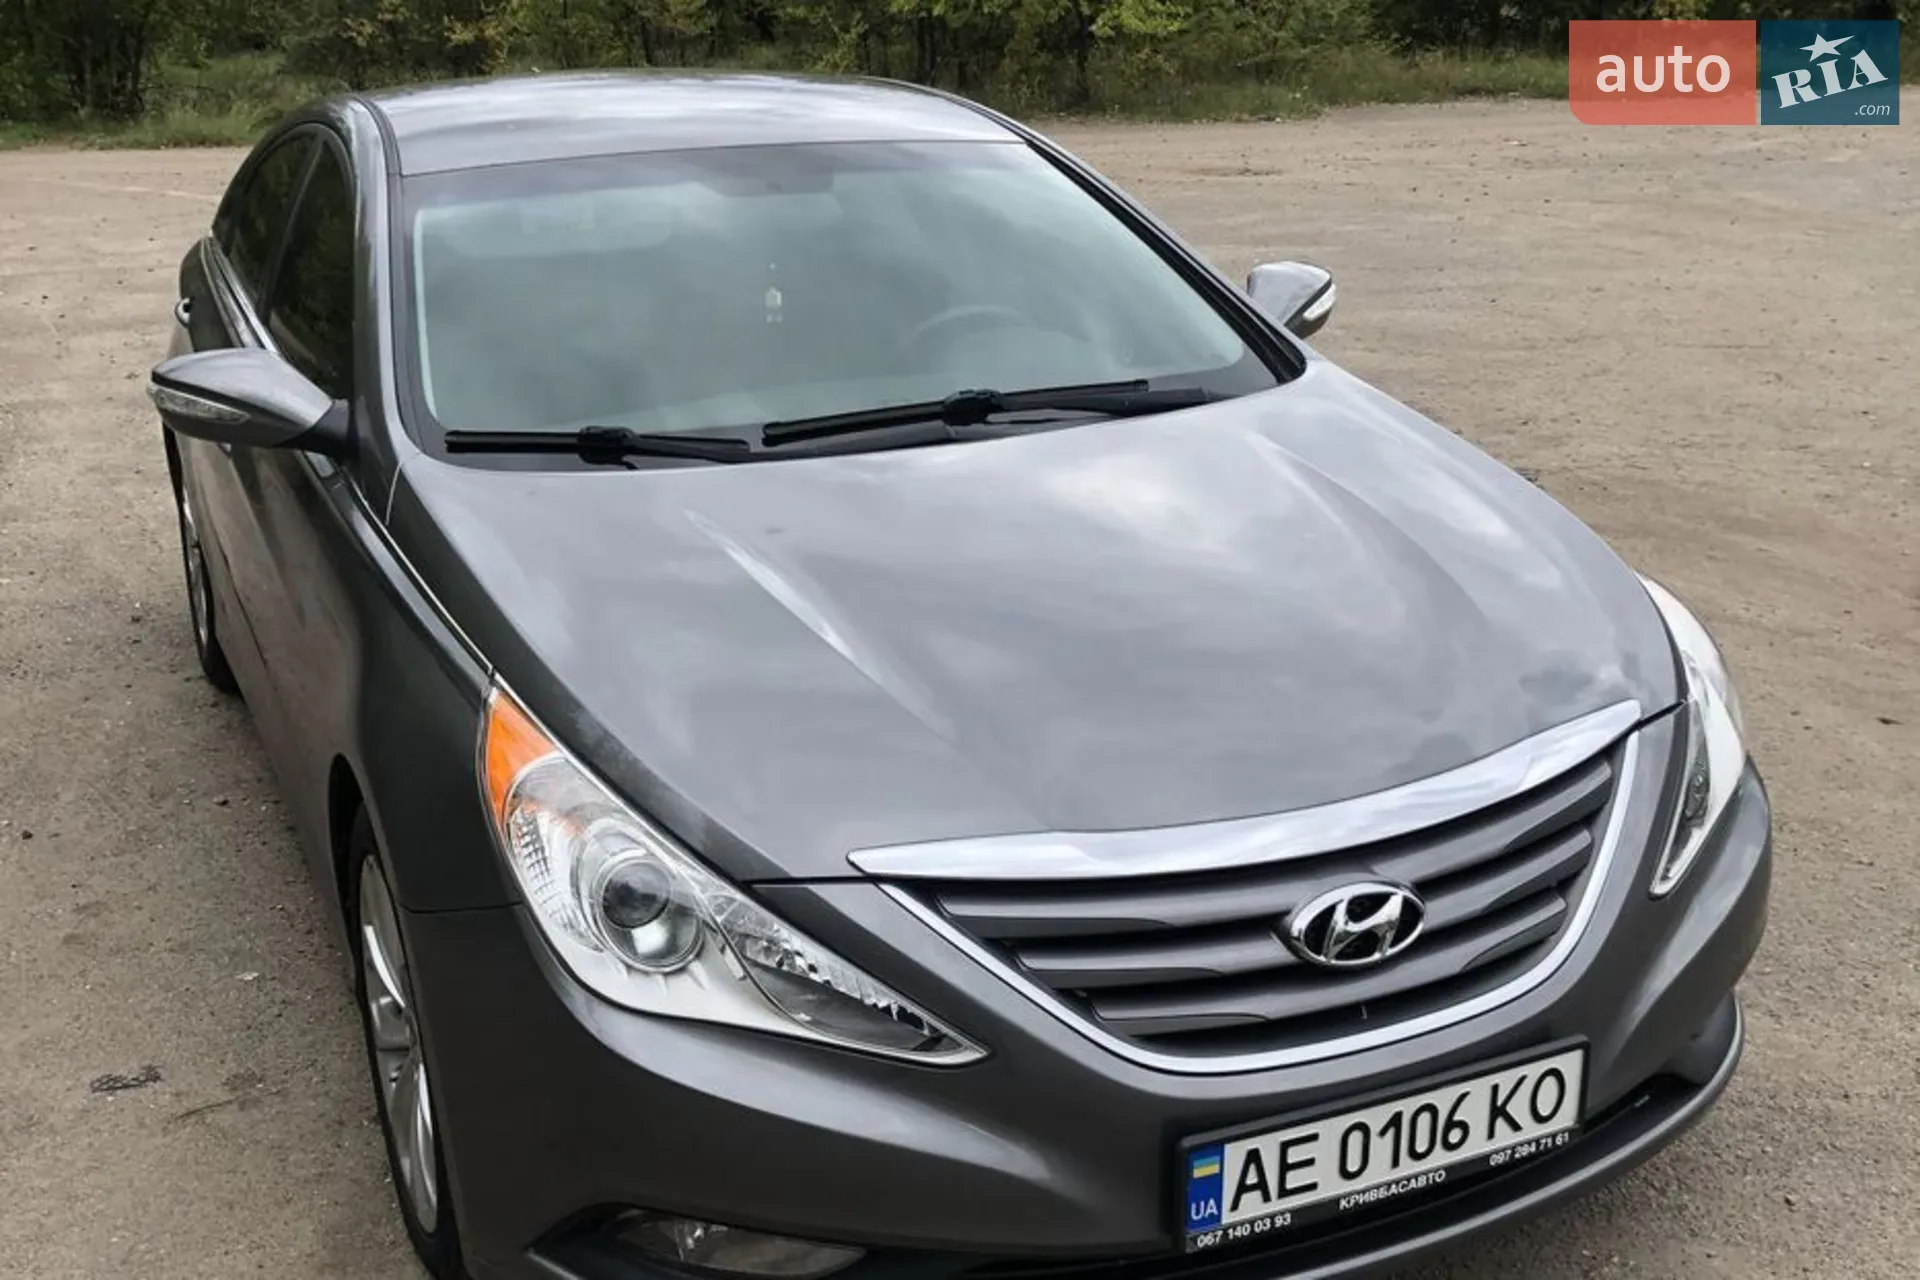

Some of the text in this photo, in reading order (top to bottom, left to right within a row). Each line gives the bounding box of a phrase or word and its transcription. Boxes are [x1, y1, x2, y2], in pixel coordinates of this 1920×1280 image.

[1229, 1067, 1566, 1213] AE 0106 KO
[1190, 1198, 1219, 1220] UA
[1339, 1169, 1447, 1211] КРИВБАСАВТО
[1197, 1212, 1292, 1248] 067 140 03 93
